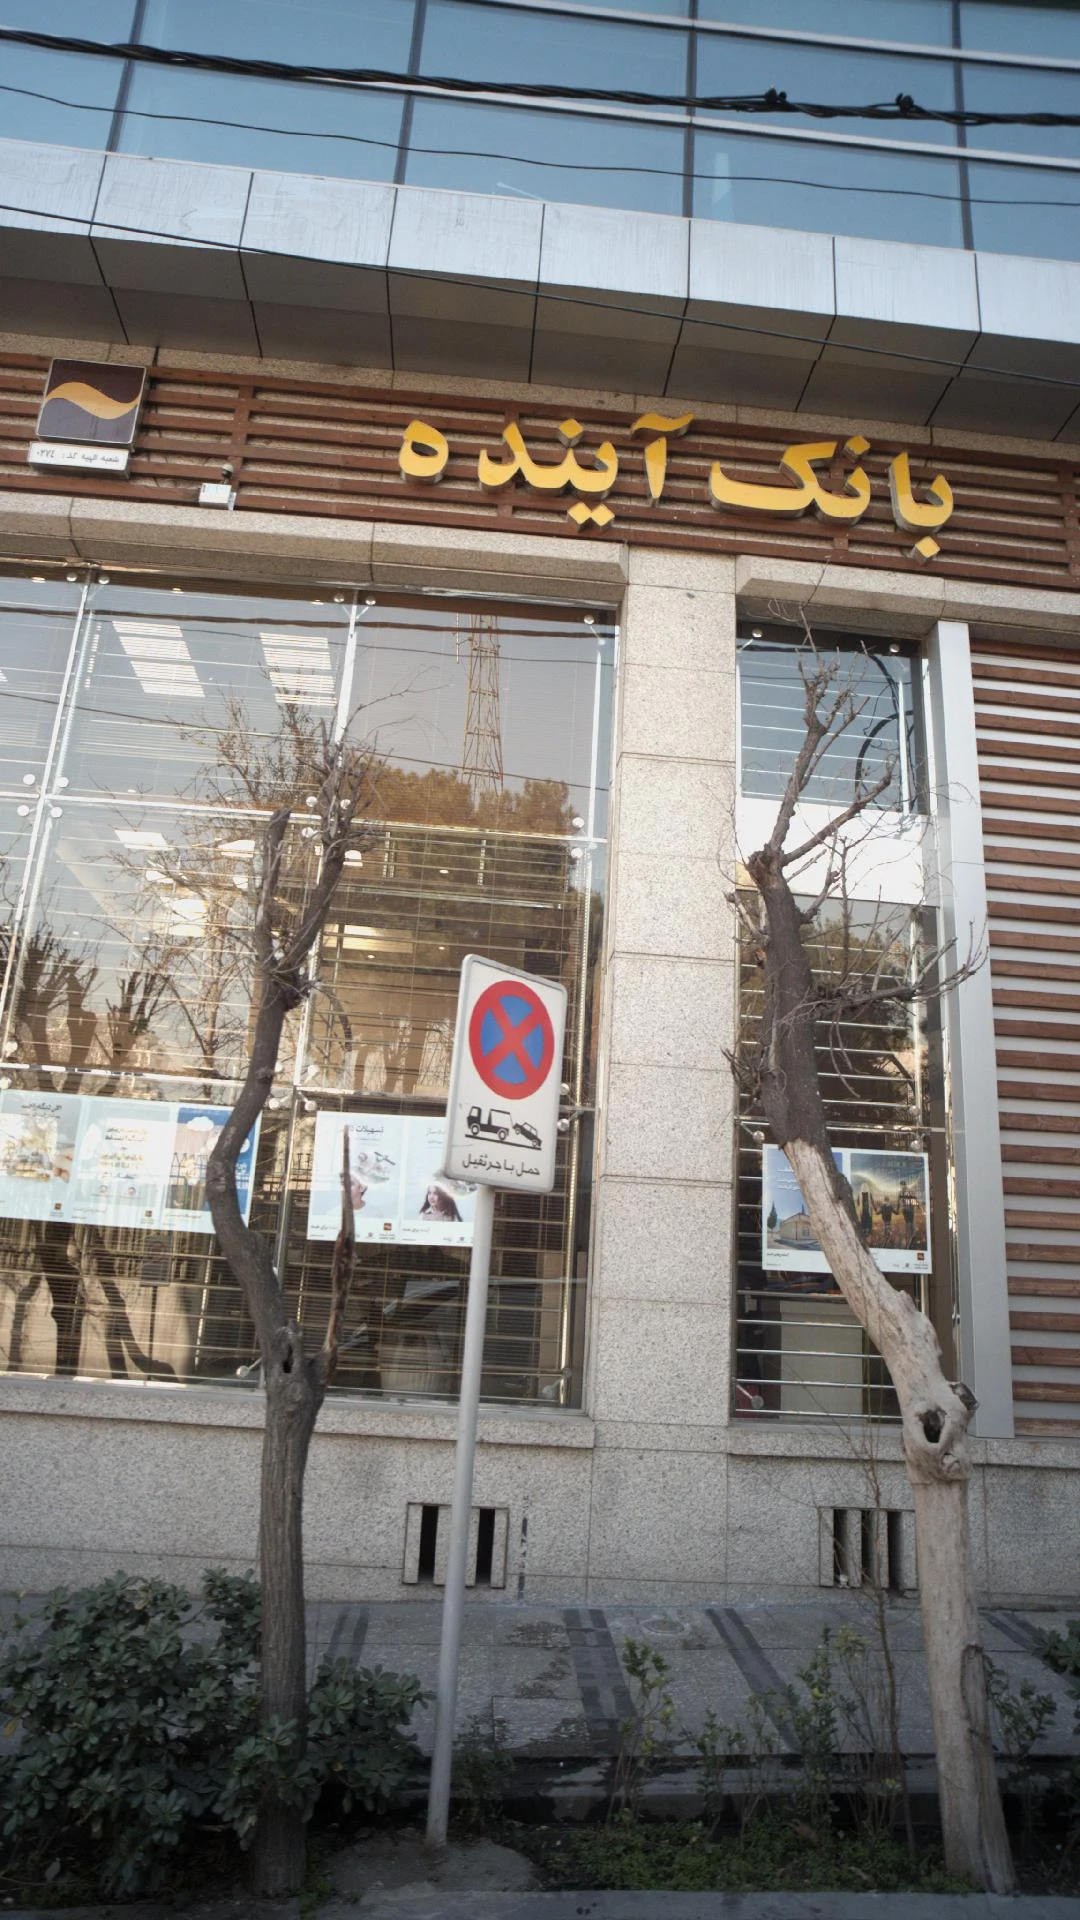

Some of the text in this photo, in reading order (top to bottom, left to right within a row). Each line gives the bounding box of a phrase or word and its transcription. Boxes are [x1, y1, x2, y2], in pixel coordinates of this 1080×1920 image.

[398, 413, 954, 565] بانک آینده
[462, 1153, 541, 1177] حمل با جرثقیل
